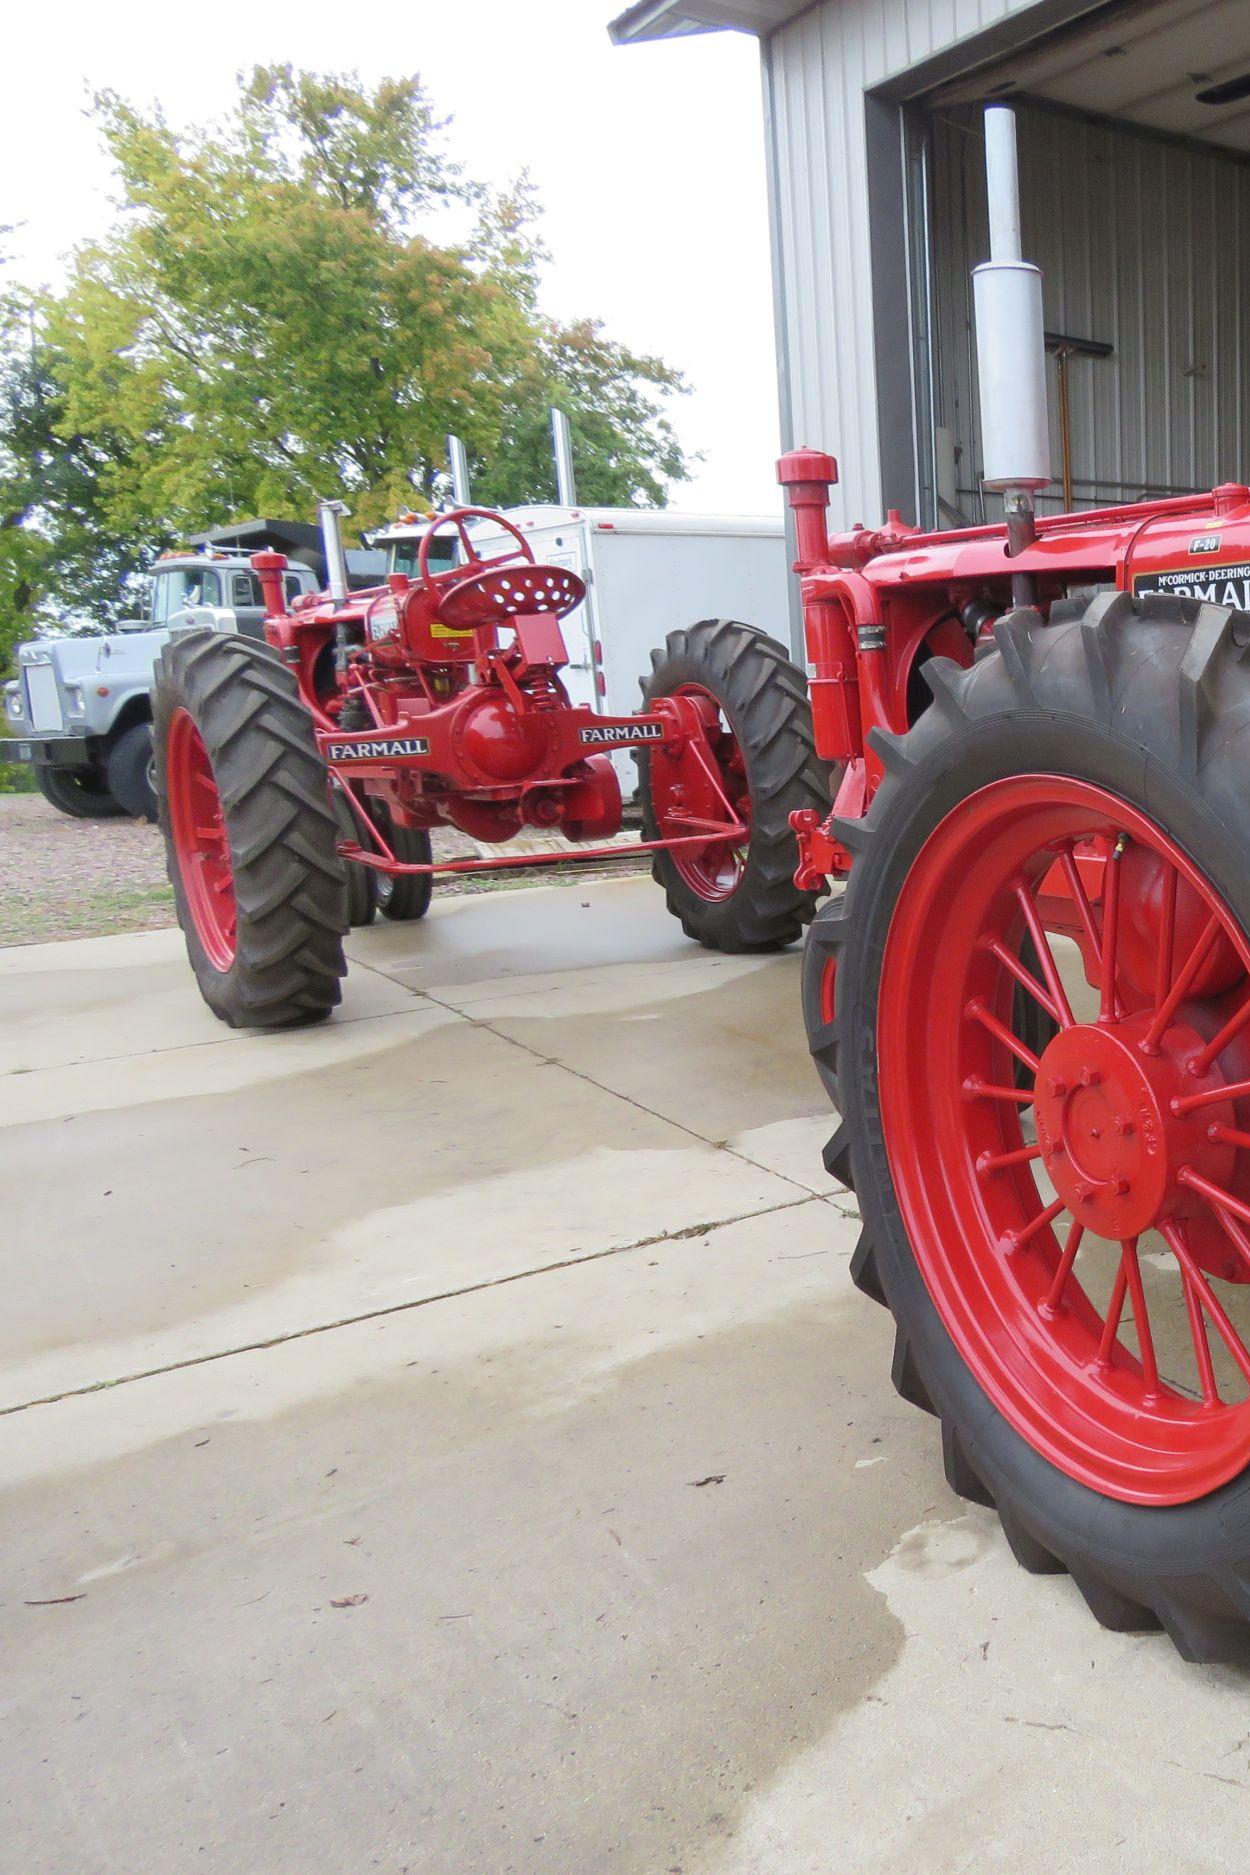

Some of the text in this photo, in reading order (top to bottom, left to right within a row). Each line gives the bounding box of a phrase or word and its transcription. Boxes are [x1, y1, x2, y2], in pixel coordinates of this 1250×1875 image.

[1193, 538, 1216, 552] F-20
[581, 725, 661, 742] FARMALL
[330, 740, 427, 760] FARMALL
